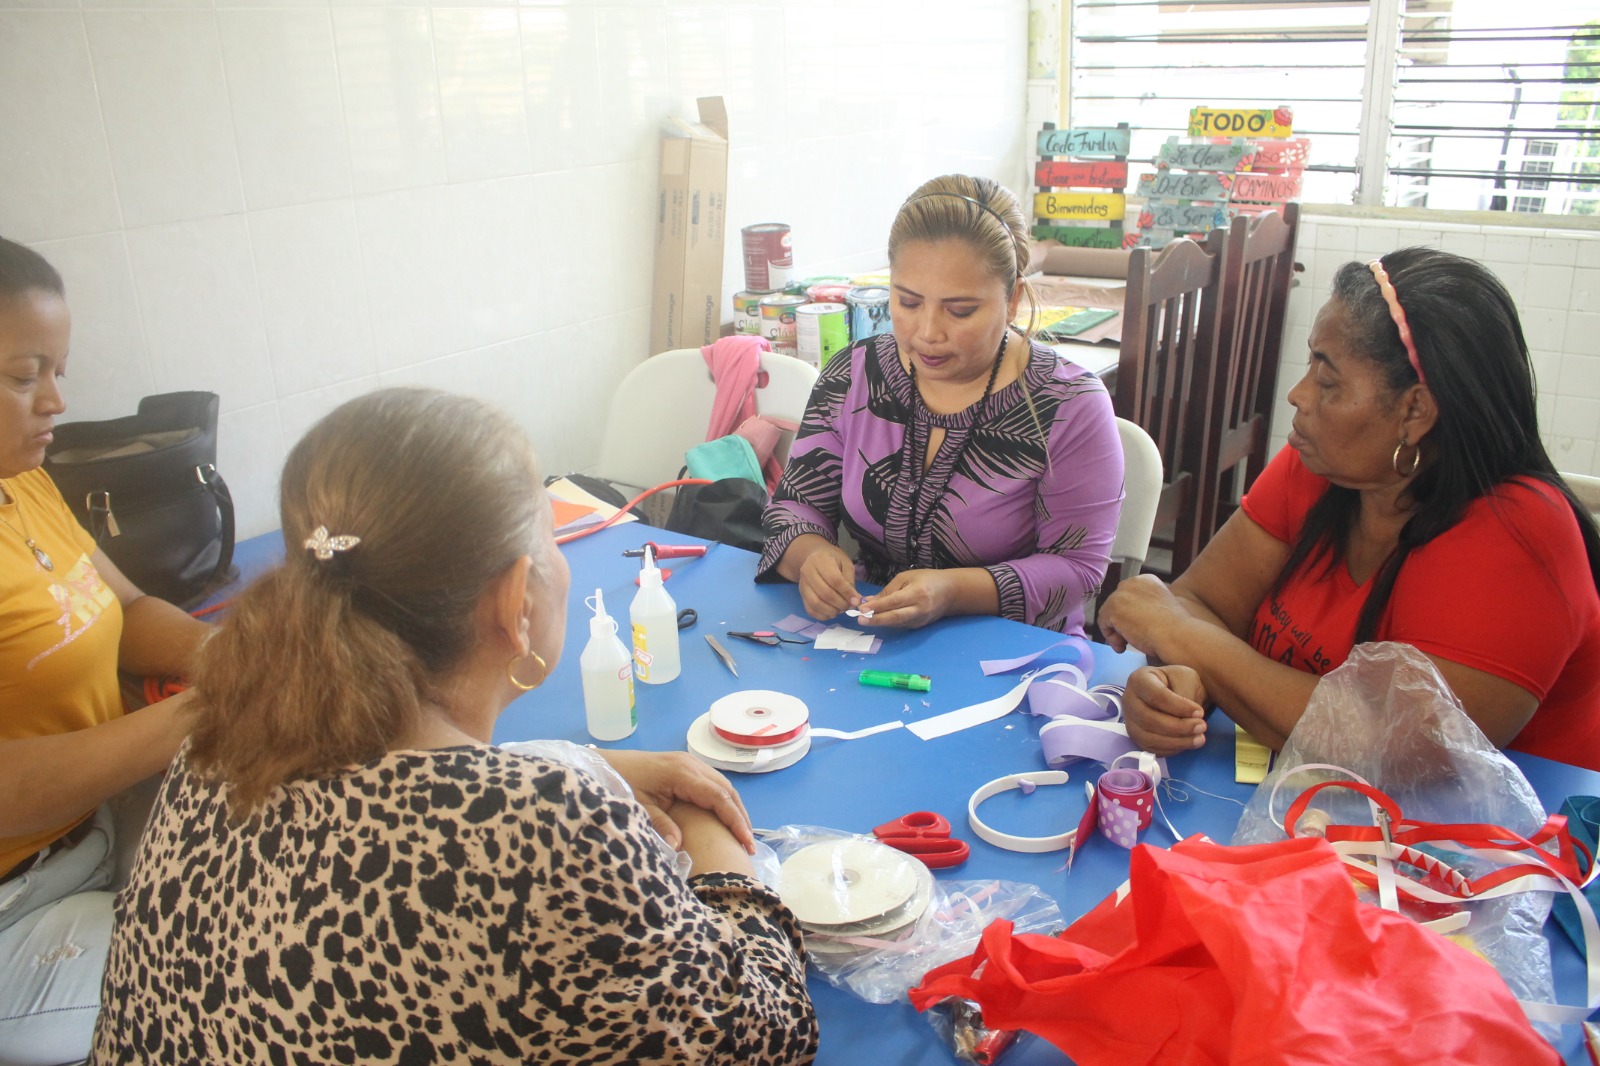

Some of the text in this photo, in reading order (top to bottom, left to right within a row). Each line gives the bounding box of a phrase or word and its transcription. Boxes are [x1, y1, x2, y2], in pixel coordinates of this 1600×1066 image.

[1200, 112, 1266, 132] TODO
[1045, 132, 1075, 154] Cada
[1237, 177, 1294, 199] CAMINOS
[1180, 208, 1207, 226] Ser
[1291, 624, 1313, 649] will
[1313, 646, 1331, 671] be
